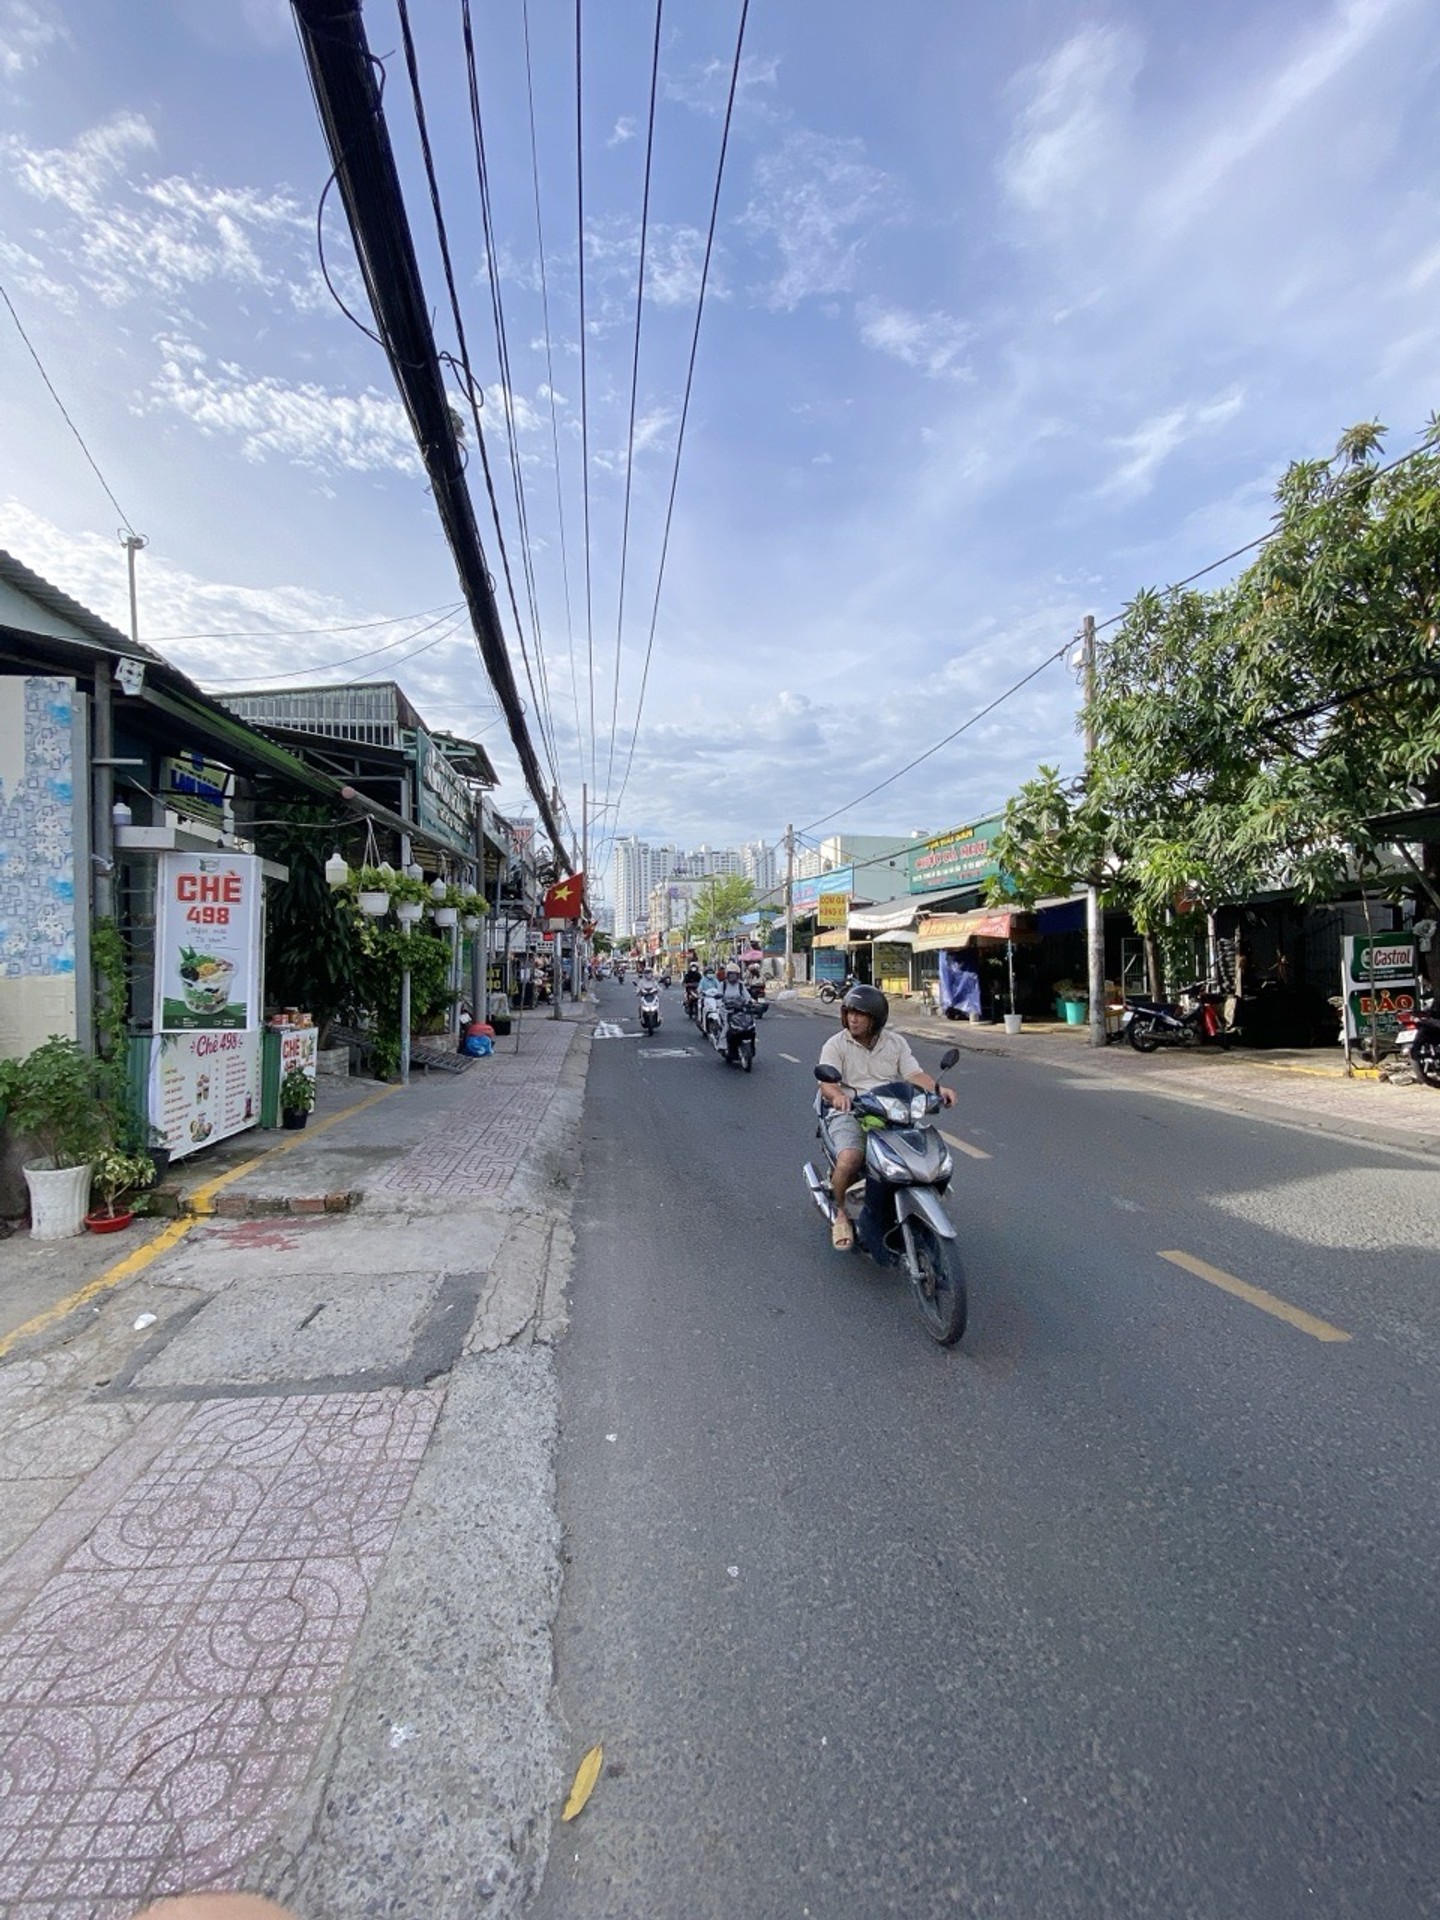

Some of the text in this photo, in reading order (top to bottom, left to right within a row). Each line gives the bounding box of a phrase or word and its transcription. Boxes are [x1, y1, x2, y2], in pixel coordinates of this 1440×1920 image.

[177, 870, 242, 903] CHÈ
[186, 906, 229, 925] 498
[1374, 949, 1411, 967] Castrol
